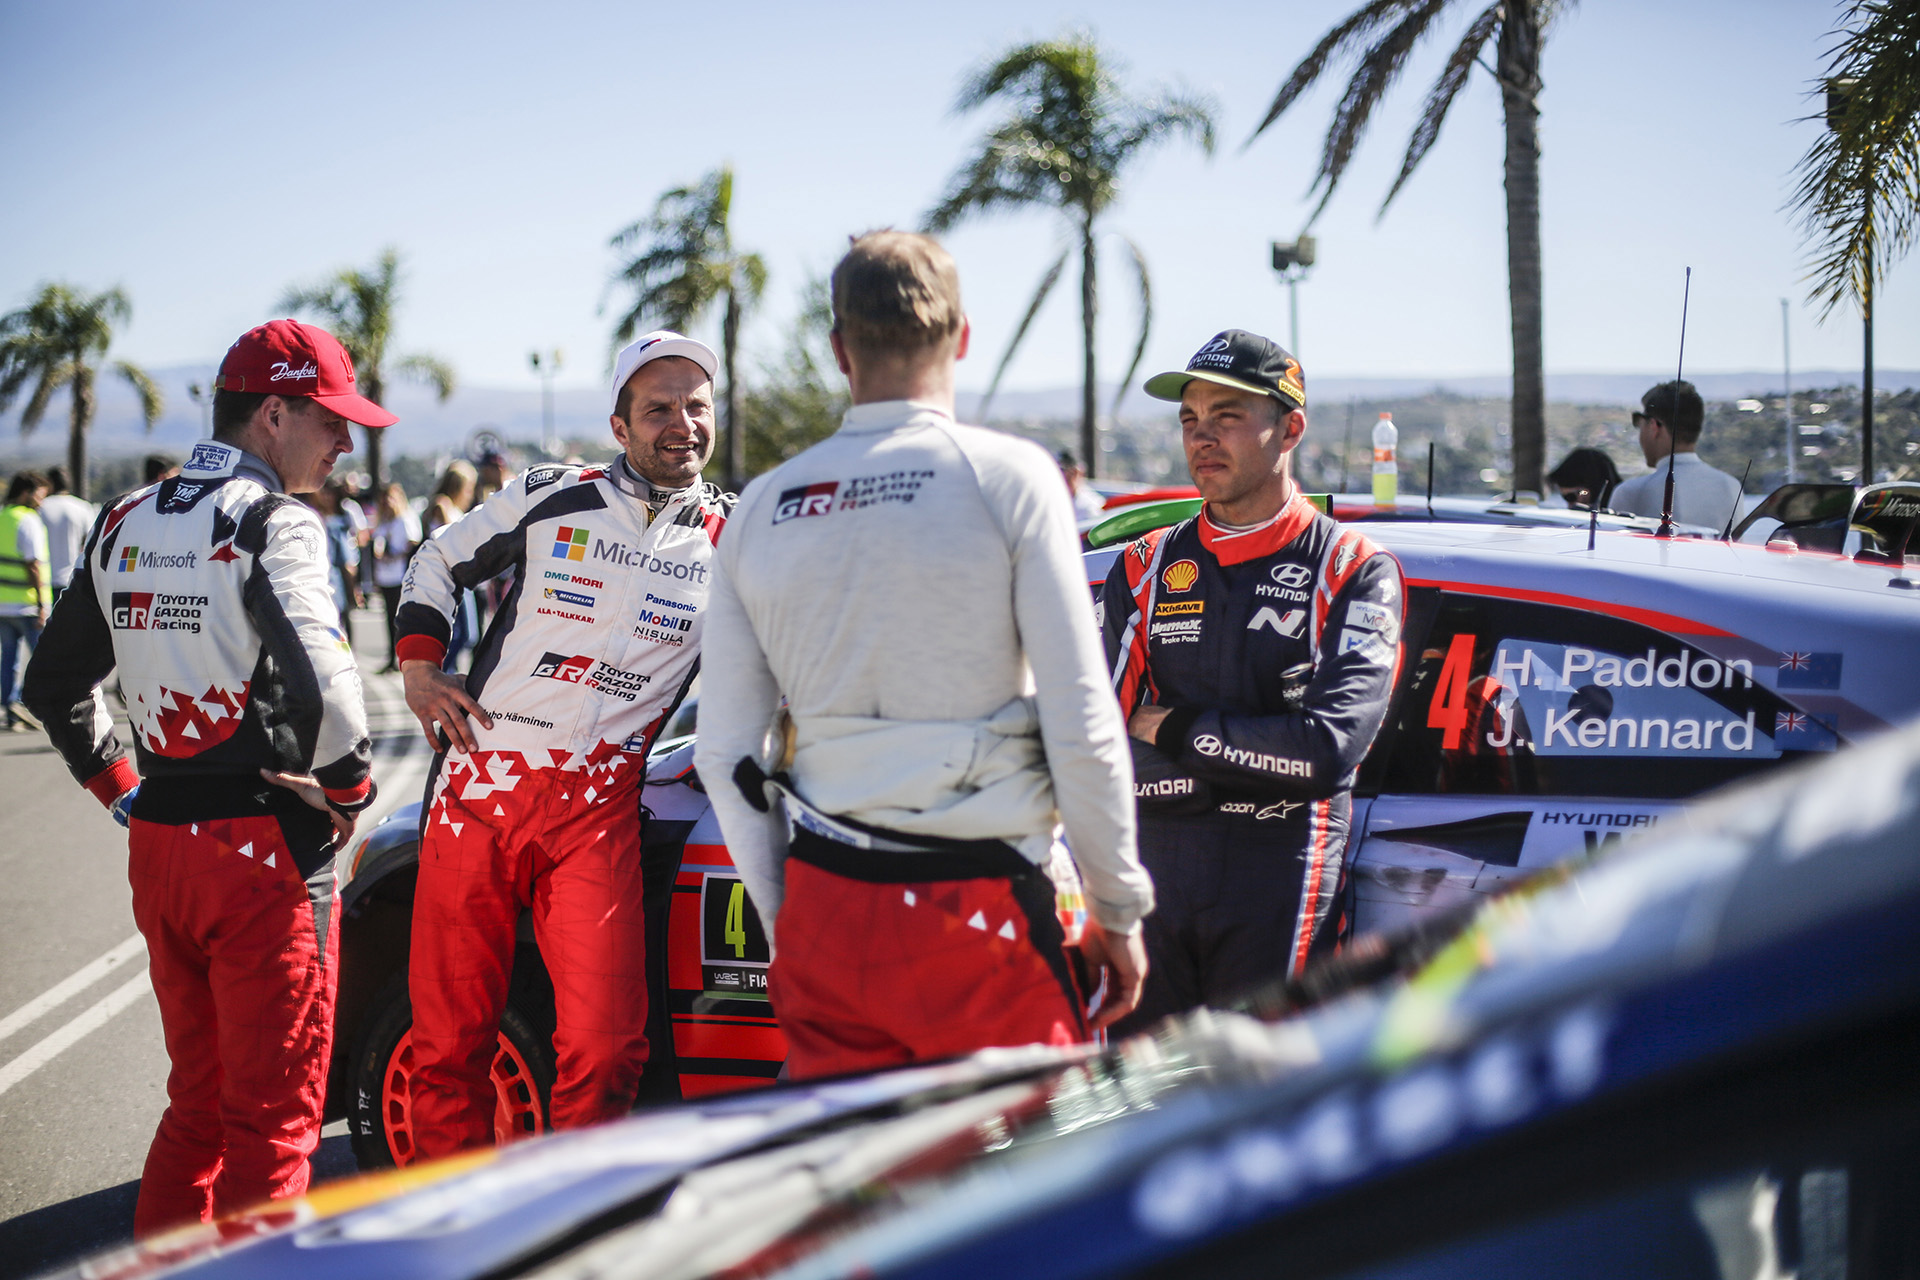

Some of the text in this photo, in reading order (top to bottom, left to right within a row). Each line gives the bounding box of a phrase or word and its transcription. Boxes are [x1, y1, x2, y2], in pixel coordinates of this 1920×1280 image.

[270, 361, 318, 381] Danfoss
[528, 471, 554, 484] OMP
[850, 470, 935, 488] TOYOTA
[650, 491, 668, 502] MP
[843, 481, 922, 499] GAZOO
[775, 494, 832, 523] GR
[839, 493, 915, 511] Racing
[139, 551, 197, 568] Microsoft
[593, 539, 707, 584] Microsoft
[544, 571, 604, 589] DMG MORI
[156, 593, 209, 606] TOYOTA
[558, 592, 594, 605] MICHELIN
[645, 593, 697, 613] Panasonic
[113, 606, 148, 628] GR
[154, 607, 202, 619] GAZOO
[639, 609, 679, 630] Mobil
[151, 619, 201, 634] Racing
[634, 626, 683, 643] NISULA
[1161, 635, 1199, 645] Brake Pads
[534, 663, 585, 682] GR
[599, 662, 651, 684] TOYOTA
[1497, 649, 1753, 689] H. Paddon
[584, 677, 637, 702] Racing
[592, 671, 643, 691] GAZOO
[1426, 634, 1476, 750] 4
[504, 711, 554, 730] Hänninen
[1486, 708, 1756, 751] J. Kennard
[1224, 745, 1311, 778] HYUNDAI
[1133, 779, 1193, 797] UNDAI
[1542, 812, 1658, 828] HYUNDAI
[725, 883, 746, 958] 4
[714, 972, 739, 980] WRC
[749, 974, 769, 988] FIA
